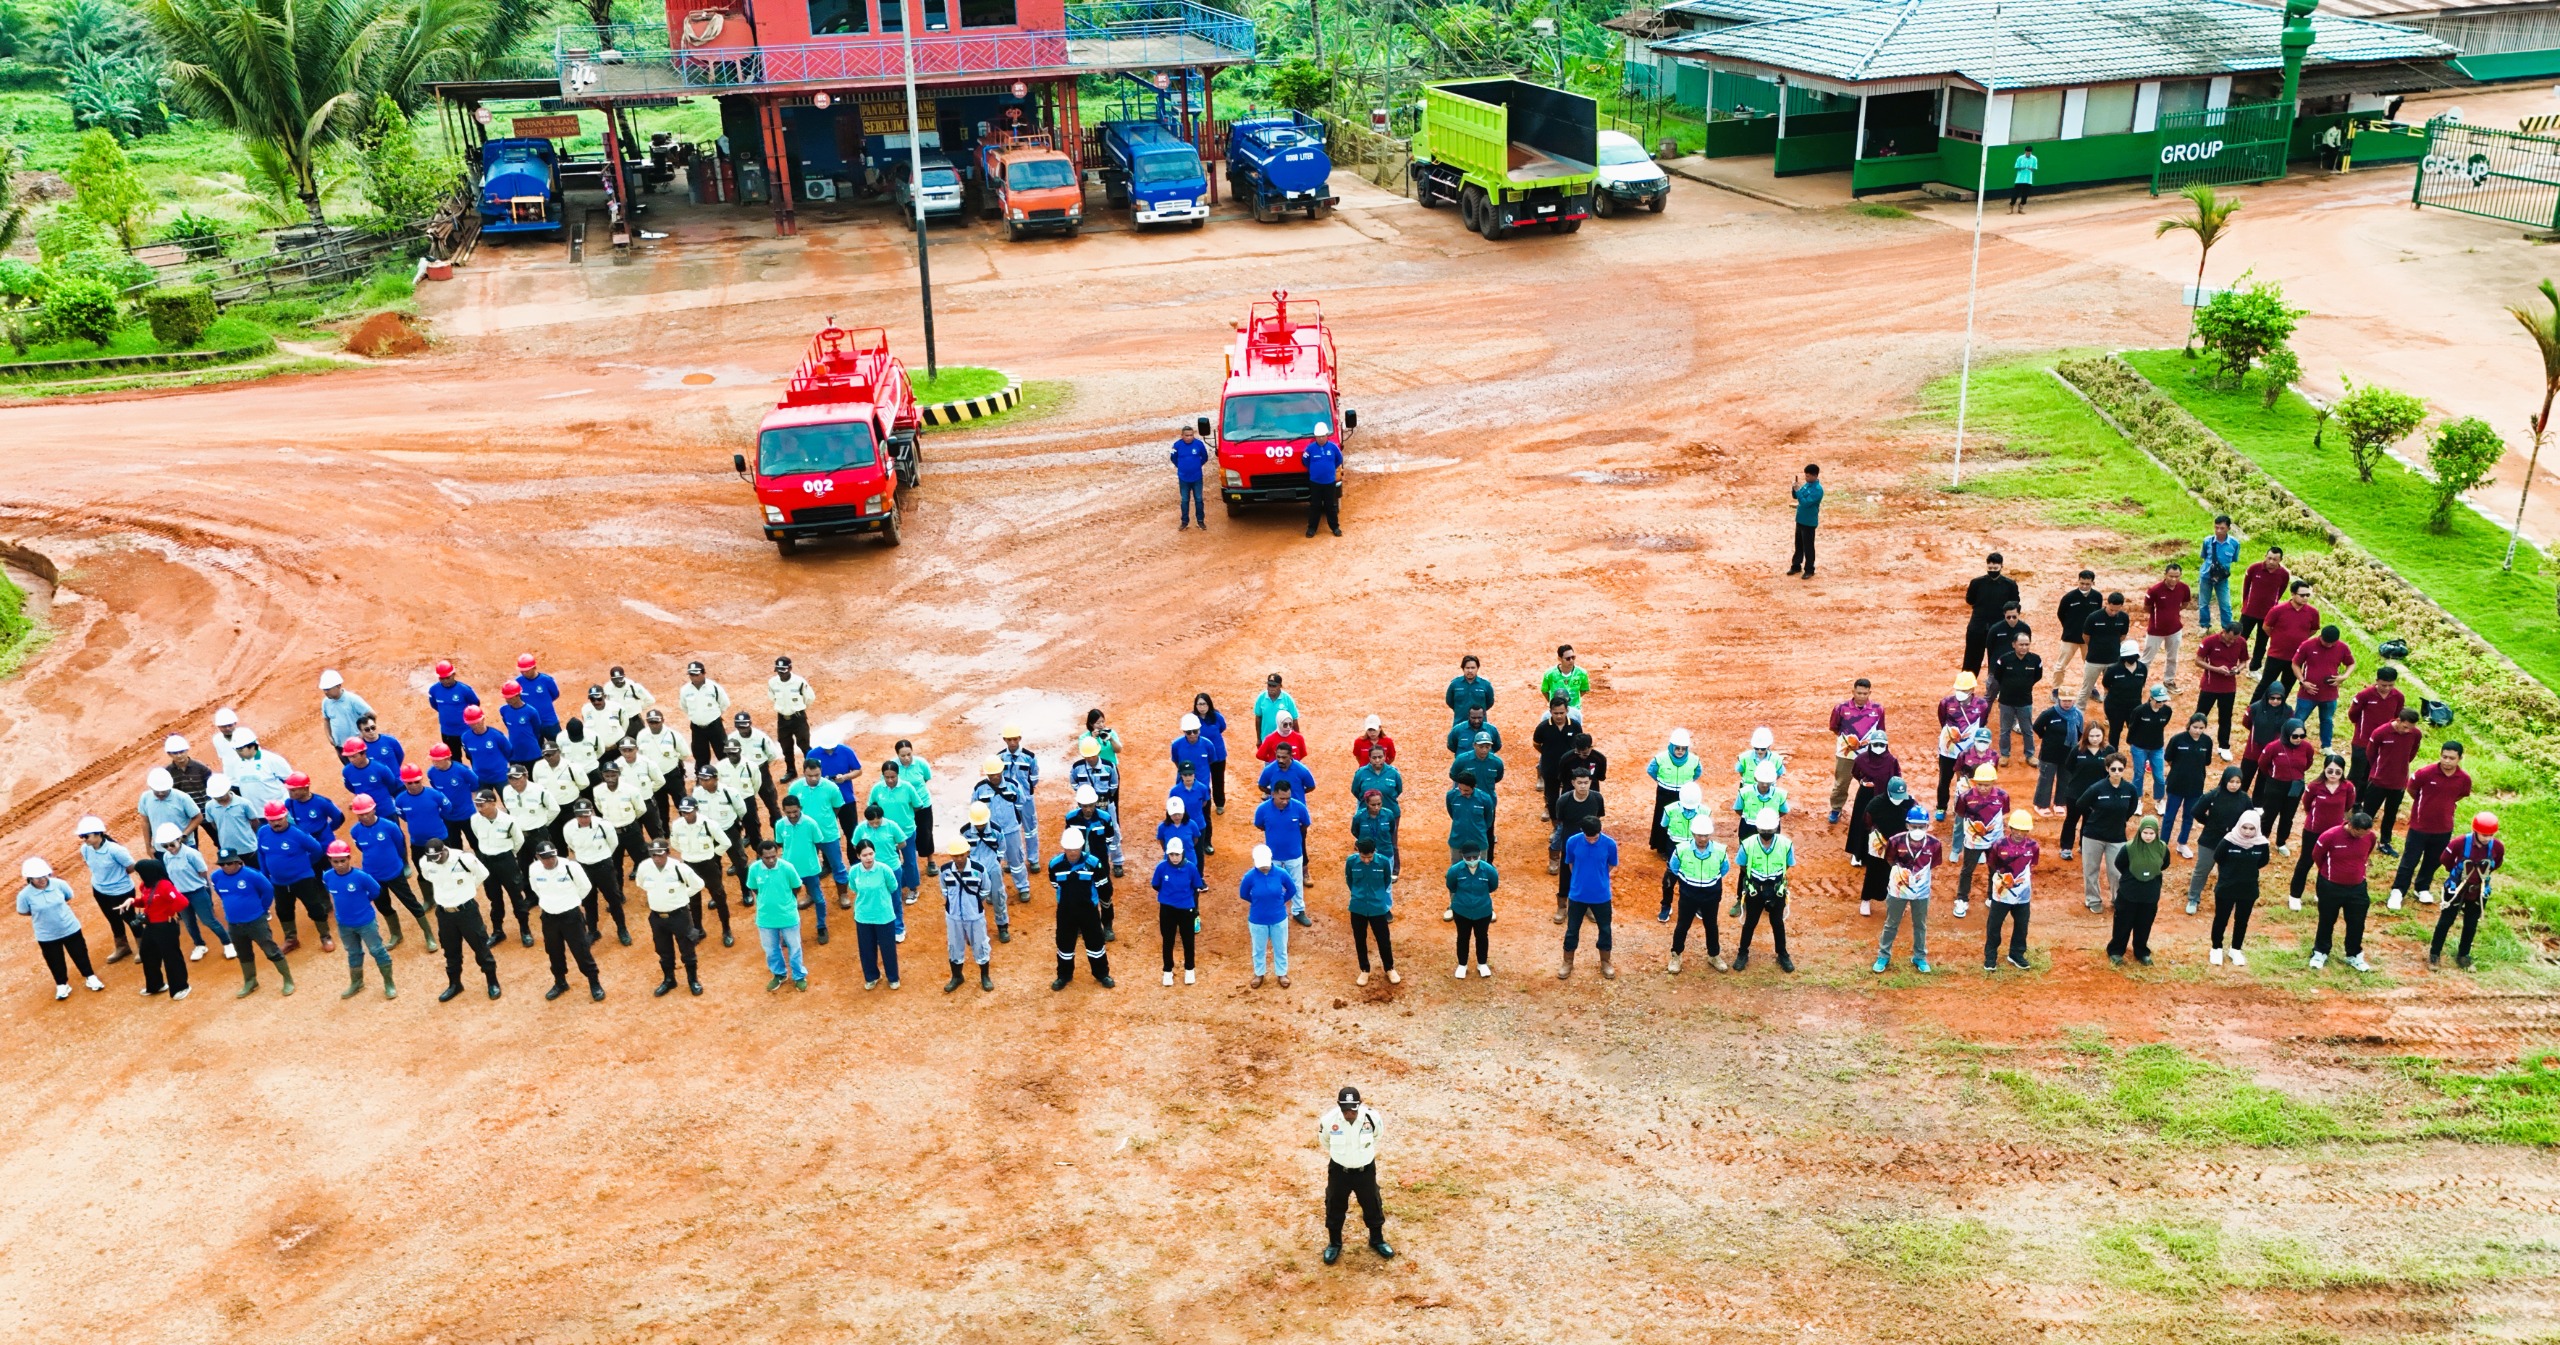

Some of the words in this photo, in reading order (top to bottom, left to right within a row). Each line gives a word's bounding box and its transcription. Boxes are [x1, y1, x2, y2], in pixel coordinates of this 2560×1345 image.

[861, 102, 899, 116] PANTANG
[901, 101, 935, 114] PANG
[514, 120, 548, 129] PANTANG
[549, 118, 578, 127] PULANG
[864, 119, 905, 134] SEBELUM
[515, 128, 552, 136] SEBELUM
[553, 126, 579, 134] PADAM
[2161, 140, 2224, 164] GROUP
[2422, 154, 2489, 182] GROUP
[1265, 446, 1294, 458] 003
[803, 479, 834, 493] 002
